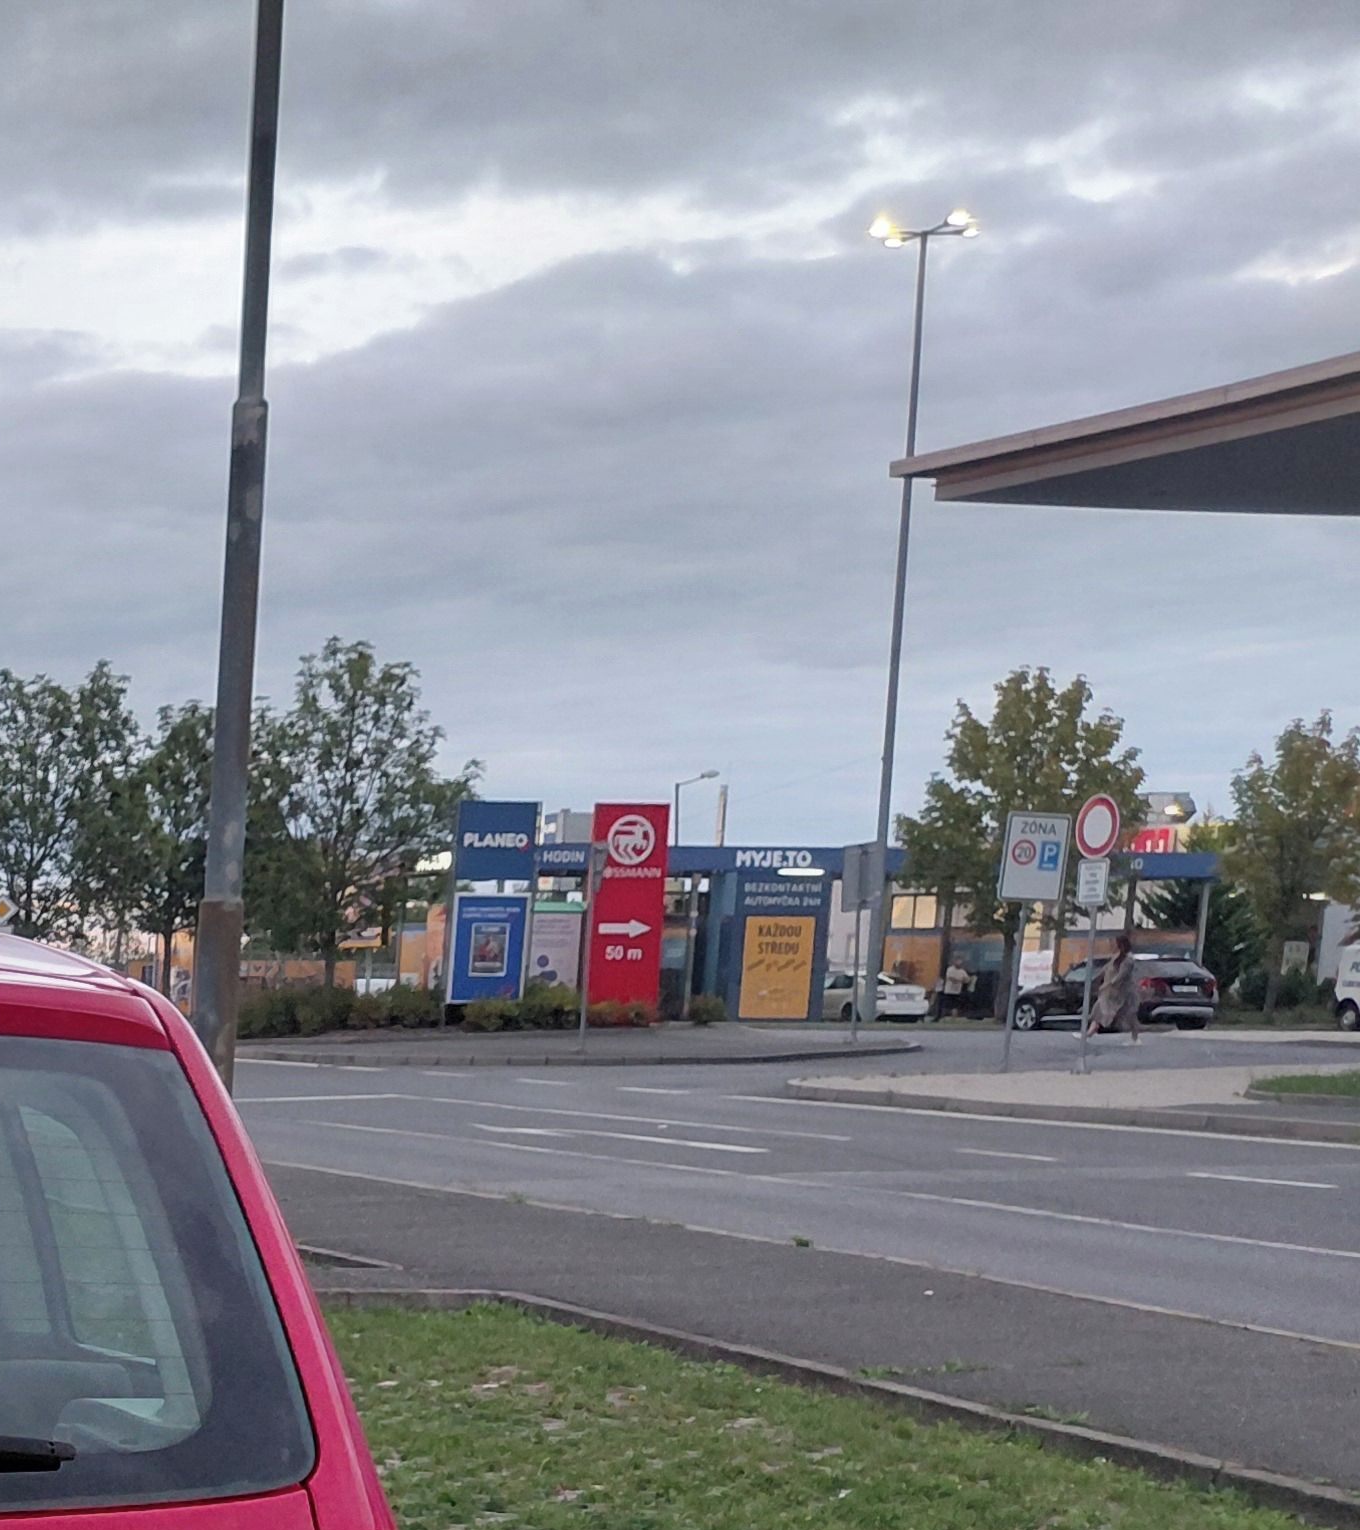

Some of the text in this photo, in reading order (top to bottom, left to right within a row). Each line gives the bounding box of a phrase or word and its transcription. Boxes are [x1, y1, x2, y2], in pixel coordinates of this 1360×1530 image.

[1021, 821, 1057, 836] ZÓNA
[463, 832, 528, 848] PLANEO
[543, 850, 585, 863] HODIN
[735, 850, 812, 868] MYJE.TO
[1017, 847, 1030, 859] 20
[602, 867, 662, 879] OSSMANN
[605, 945, 642, 960] 50 m
